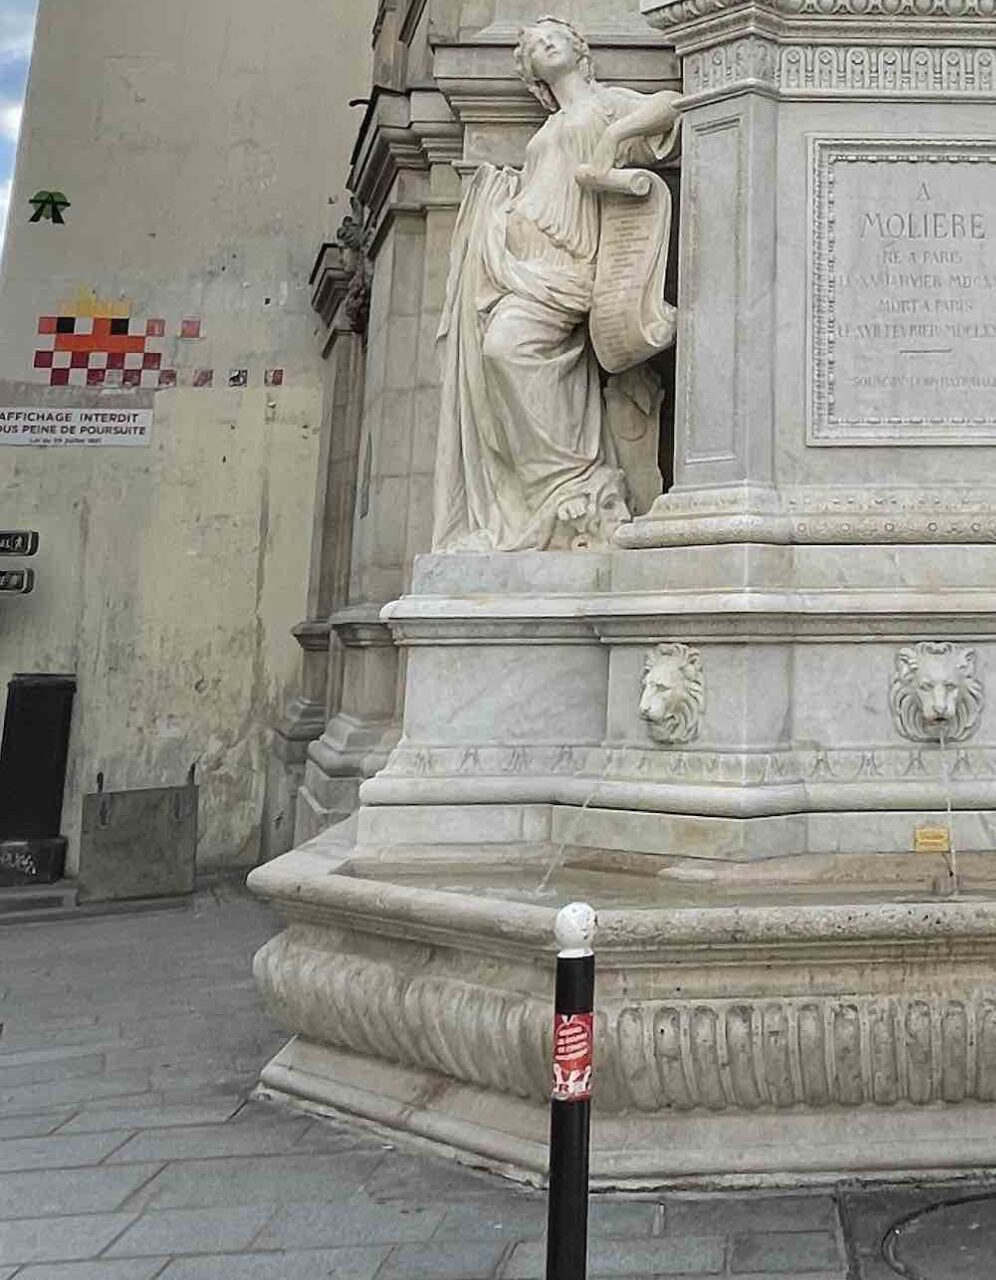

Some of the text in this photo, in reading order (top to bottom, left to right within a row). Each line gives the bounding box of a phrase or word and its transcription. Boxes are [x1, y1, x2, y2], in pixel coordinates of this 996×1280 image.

[914, 181, 931, 201] A
[859, 212, 986, 239] MOLIERE
[923, 250, 963, 265] PARIS
[0, 411, 139, 424] AFFICHAGE INTERDIT
[22, 425, 56, 436] PEINE
[60, 425, 76, 436] DE
[80, 426, 146, 437] POURSUITE
